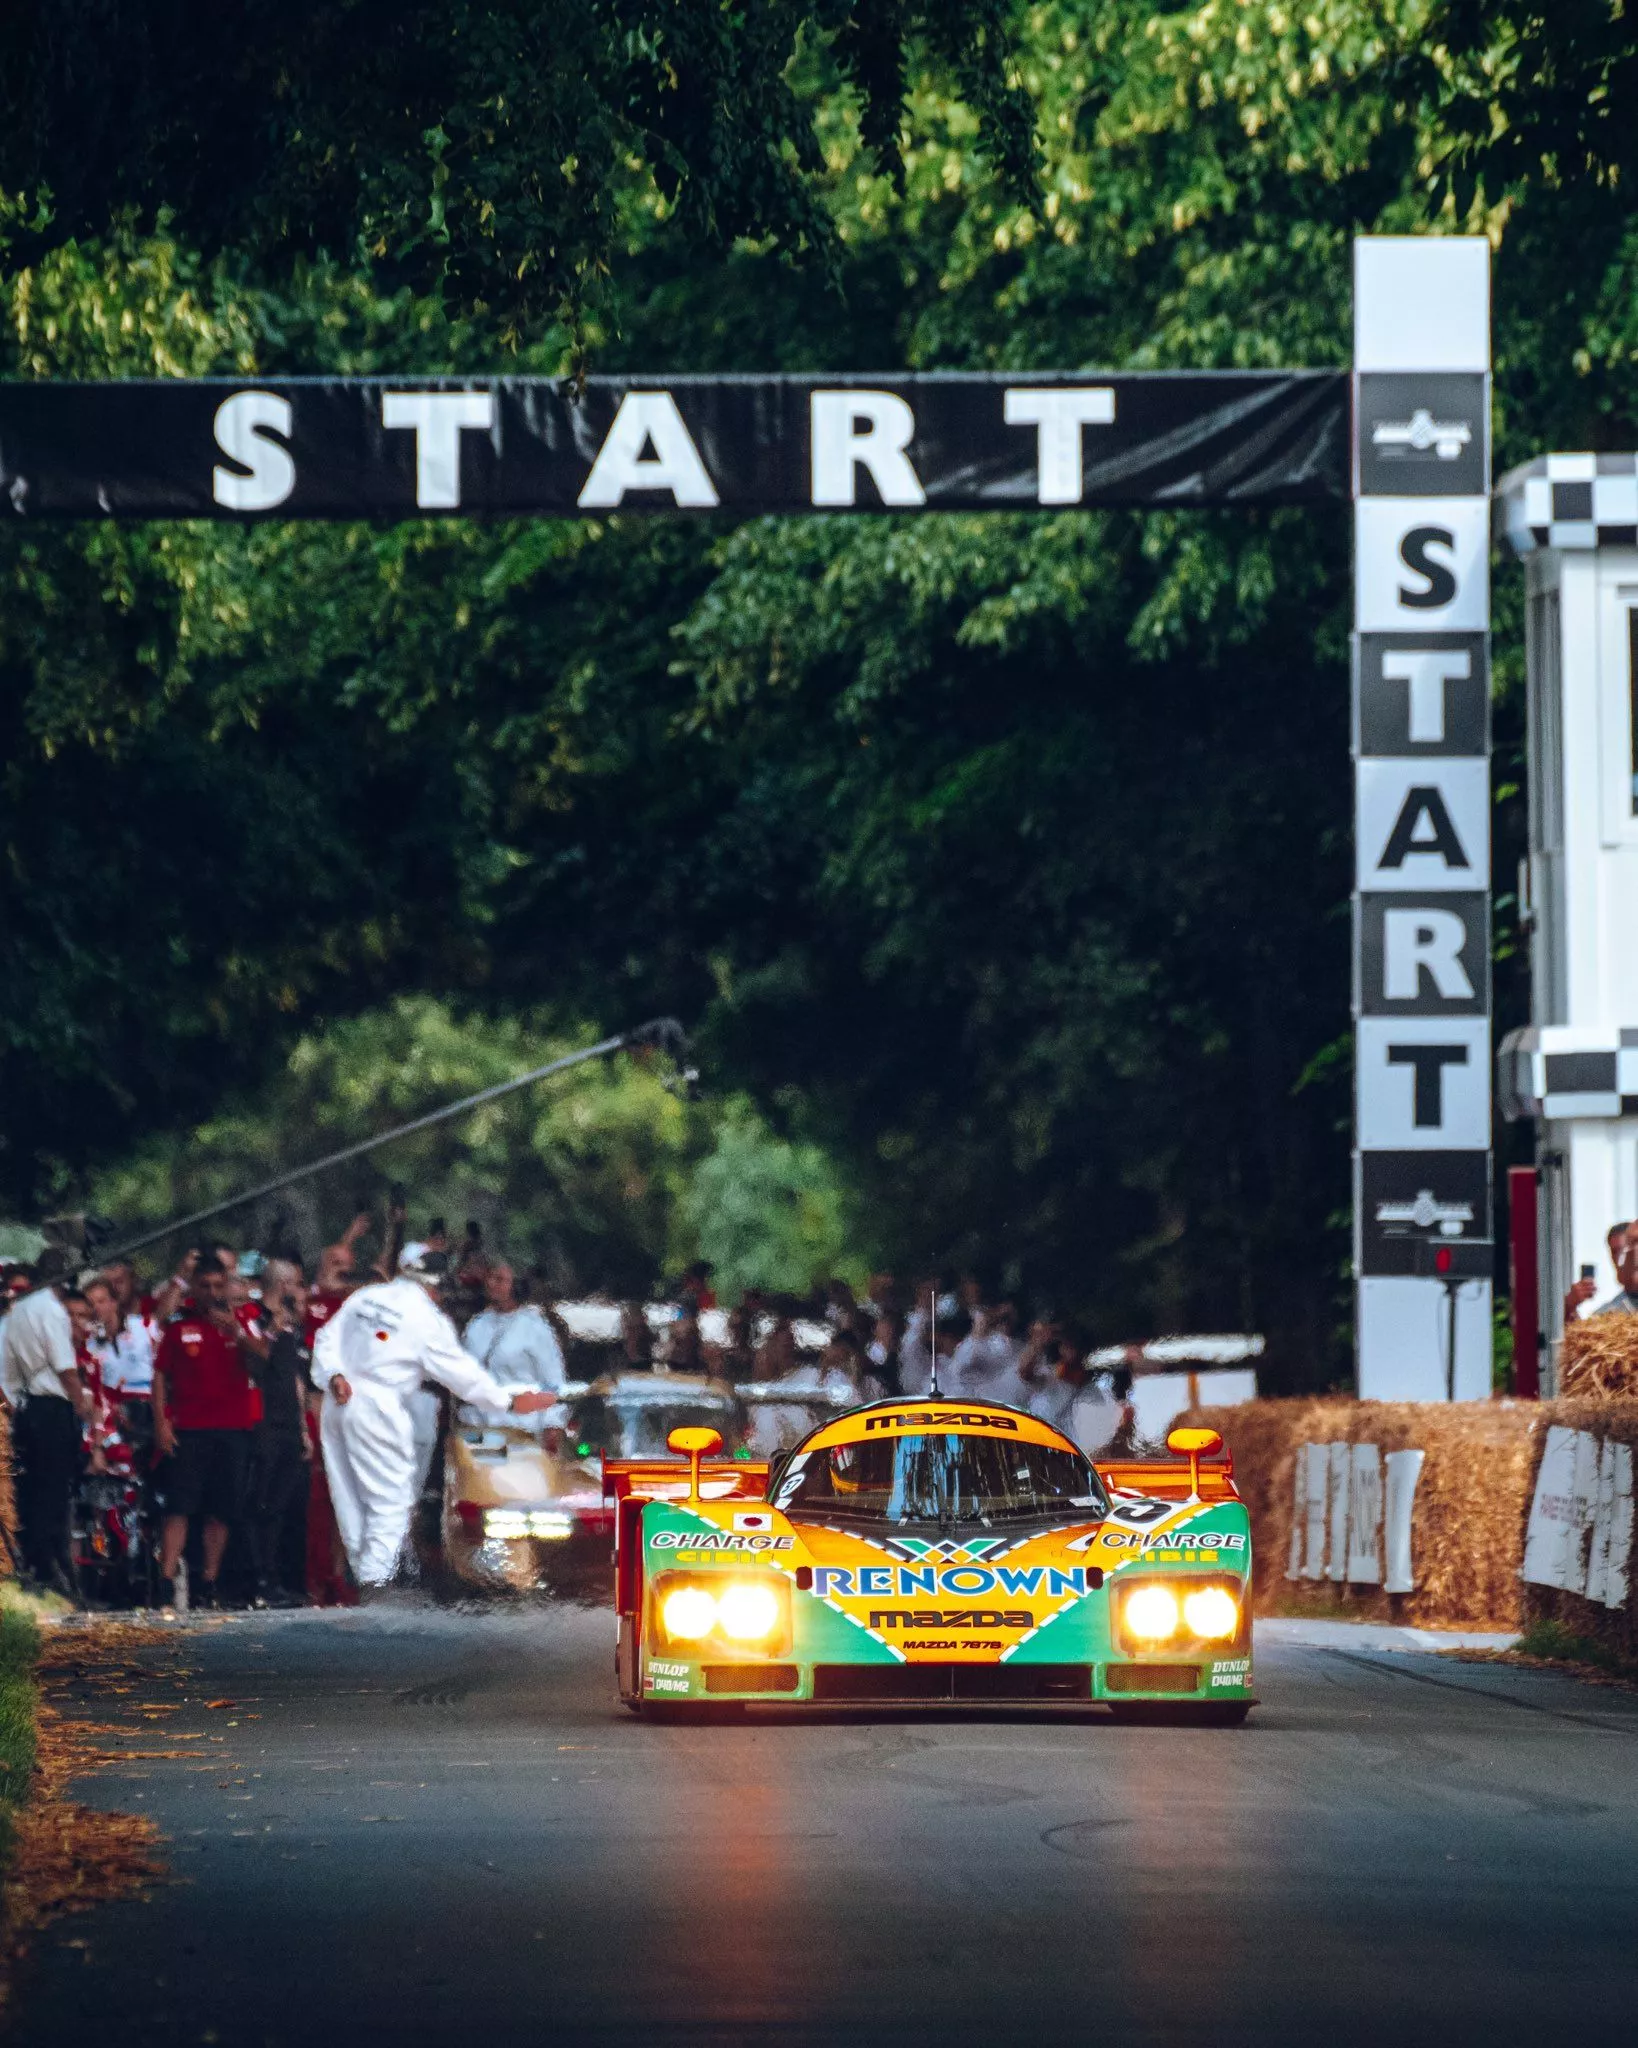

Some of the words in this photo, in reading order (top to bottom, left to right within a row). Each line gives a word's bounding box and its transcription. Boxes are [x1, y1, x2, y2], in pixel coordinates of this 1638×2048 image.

[212, 388, 1116, 511] START
[1376, 525, 1476, 1129] START
[651, 1532, 794, 1551] CHARGE
[1101, 1532, 1246, 1550] CHARGE
[812, 1566, 1087, 1597] RENOWN
[902, 1640, 957, 1649] MAZDA
[647, 1661, 690, 1676] DUNLOP
[1211, 1660, 1250, 1673] DUNLOP
